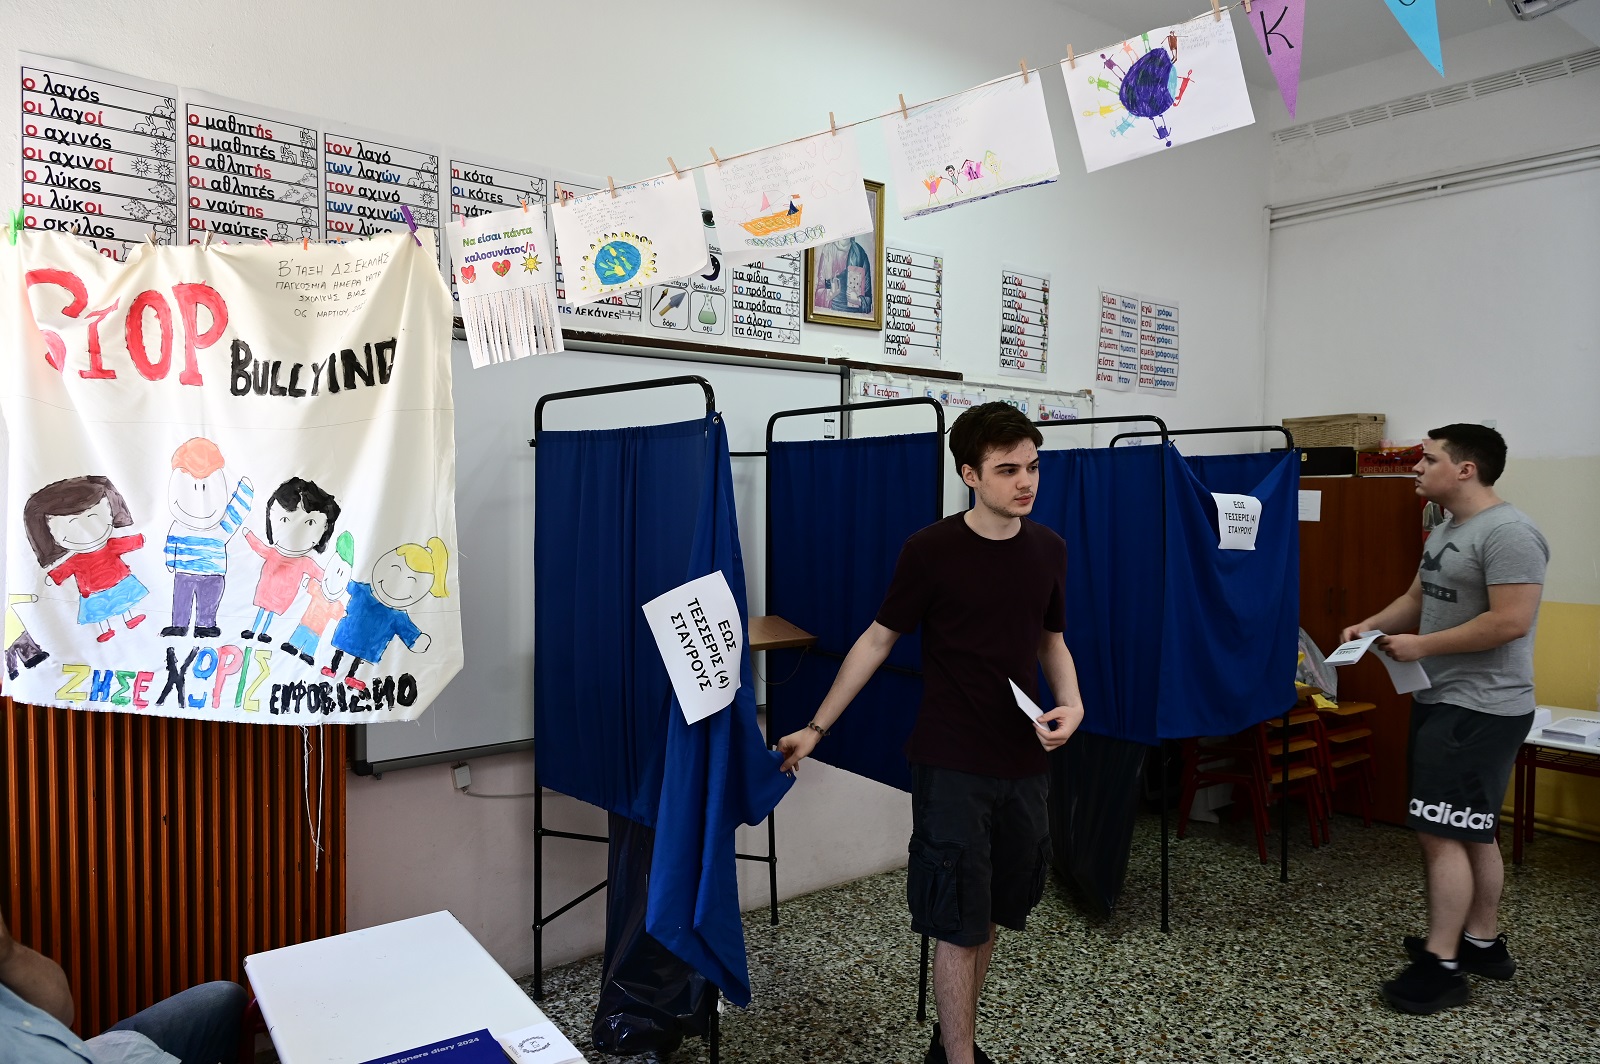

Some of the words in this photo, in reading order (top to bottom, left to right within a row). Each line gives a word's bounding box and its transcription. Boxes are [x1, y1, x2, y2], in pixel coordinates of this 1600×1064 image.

[23, 78, 35, 90] ο
[44, 74, 100, 102] λαγός
[23, 100, 43, 115] οι
[50, 98, 104, 126] λαγοί
[188, 113, 200, 126] ο
[206, 115, 272, 140] μαθητής
[25, 124, 38, 137] ο
[44, 127, 112, 150] αχινός
[188, 134, 206, 148] οι
[211, 136, 276, 160] μαθητές
[326, 142, 352, 156] τον
[357, 142, 390, 166] λαγό
[23, 147, 43, 161] οι
[50, 150, 114, 173] αχινοί
[188, 154, 200, 167] ο
[206, 156, 272, 178] αθλητής
[24, 170, 37, 182] ο
[45, 166, 101, 192] λύκος
[326, 161, 352, 176] των
[358, 161, 400, 183] λαγών
[452, 168, 460, 180] η
[464, 168, 494, 184] κότα
[190, 176, 206, 189] οι
[211, 177, 275, 200] αθλητές
[326, 181, 354, 196] τον
[358, 184, 400, 204] αχινό
[452, 186, 464, 197] οι
[468, 188, 503, 204] κότες
[557, 189, 574, 199] ης
[24, 192, 42, 206] οι
[50, 189, 104, 216] λύκοι
[189, 196, 200, 209] ο
[207, 197, 264, 218] ναύτης
[326, 200, 353, 214] των
[452, 203, 460, 214] η
[24, 215, 38, 228] ο
[190, 217, 206, 230] οι
[211, 218, 268, 239] ναύτες
[327, 220, 354, 233] τον
[462, 238, 476, 247] Να
[478, 232, 502, 244] είσαι
[503, 226, 533, 238] πάντα
[887, 252, 912, 265] ξυπνώ
[296, 265, 324, 276] ΤΑΞΗ
[734, 270, 744, 278] τα
[746, 271, 769, 284] φίδια
[887, 266, 912, 278] κεντώ
[333, 280, 362, 290] ΗΜΕΡΑ
[746, 285, 781, 300] πρόβατο
[888, 280, 906, 291] νικώ
[1002, 287, 1027, 299] ποτίζω
[347, 289, 366, 300] ΒΙΑΣ
[886, 293, 912, 305] αγαπώ
[558, 306, 572, 314] τις
[734, 300, 744, 308] τα
[746, 300, 781, 314] πρόβατα
[887, 302, 910, 318] βουτώ
[746, 313, 772, 328] άλογο
[886, 316, 916, 332] κλοτσώ
[1002, 309, 1029, 324] στολίζω
[734, 326, 744, 335] τα
[746, 326, 772, 340] άλογα
[886, 334, 910, 344] κρατώ
[886, 344, 907, 356] πηδώ
[1001, 346, 1028, 358] χτενίζω
[873, 384, 900, 399] Τετάρτη
[950, 394, 972, 406] Ιουνίου
[1233, 501, 1246, 509] ΕΩΣ
[1225, 512, 1249, 521] ΤΕΣΣΕΡΙΣ
[1228, 526, 1252, 534] ΣΤΑΥΡΟΥΣ
[688, 597, 724, 668] ΤΕΣΣΕΡΙΣ
[714, 670, 730, 689] (4)
[718, 620, 737, 652] ΕΩΣ
[670, 612, 712, 691] ΣΤΑΥΡΟΥΣ
[55, 664, 154, 710] ΖΗΣΕ
[1409, 798, 1494, 830] adidas
[430, 1044, 455, 1055] diary
[457, 1037, 480, 1048] 2024
